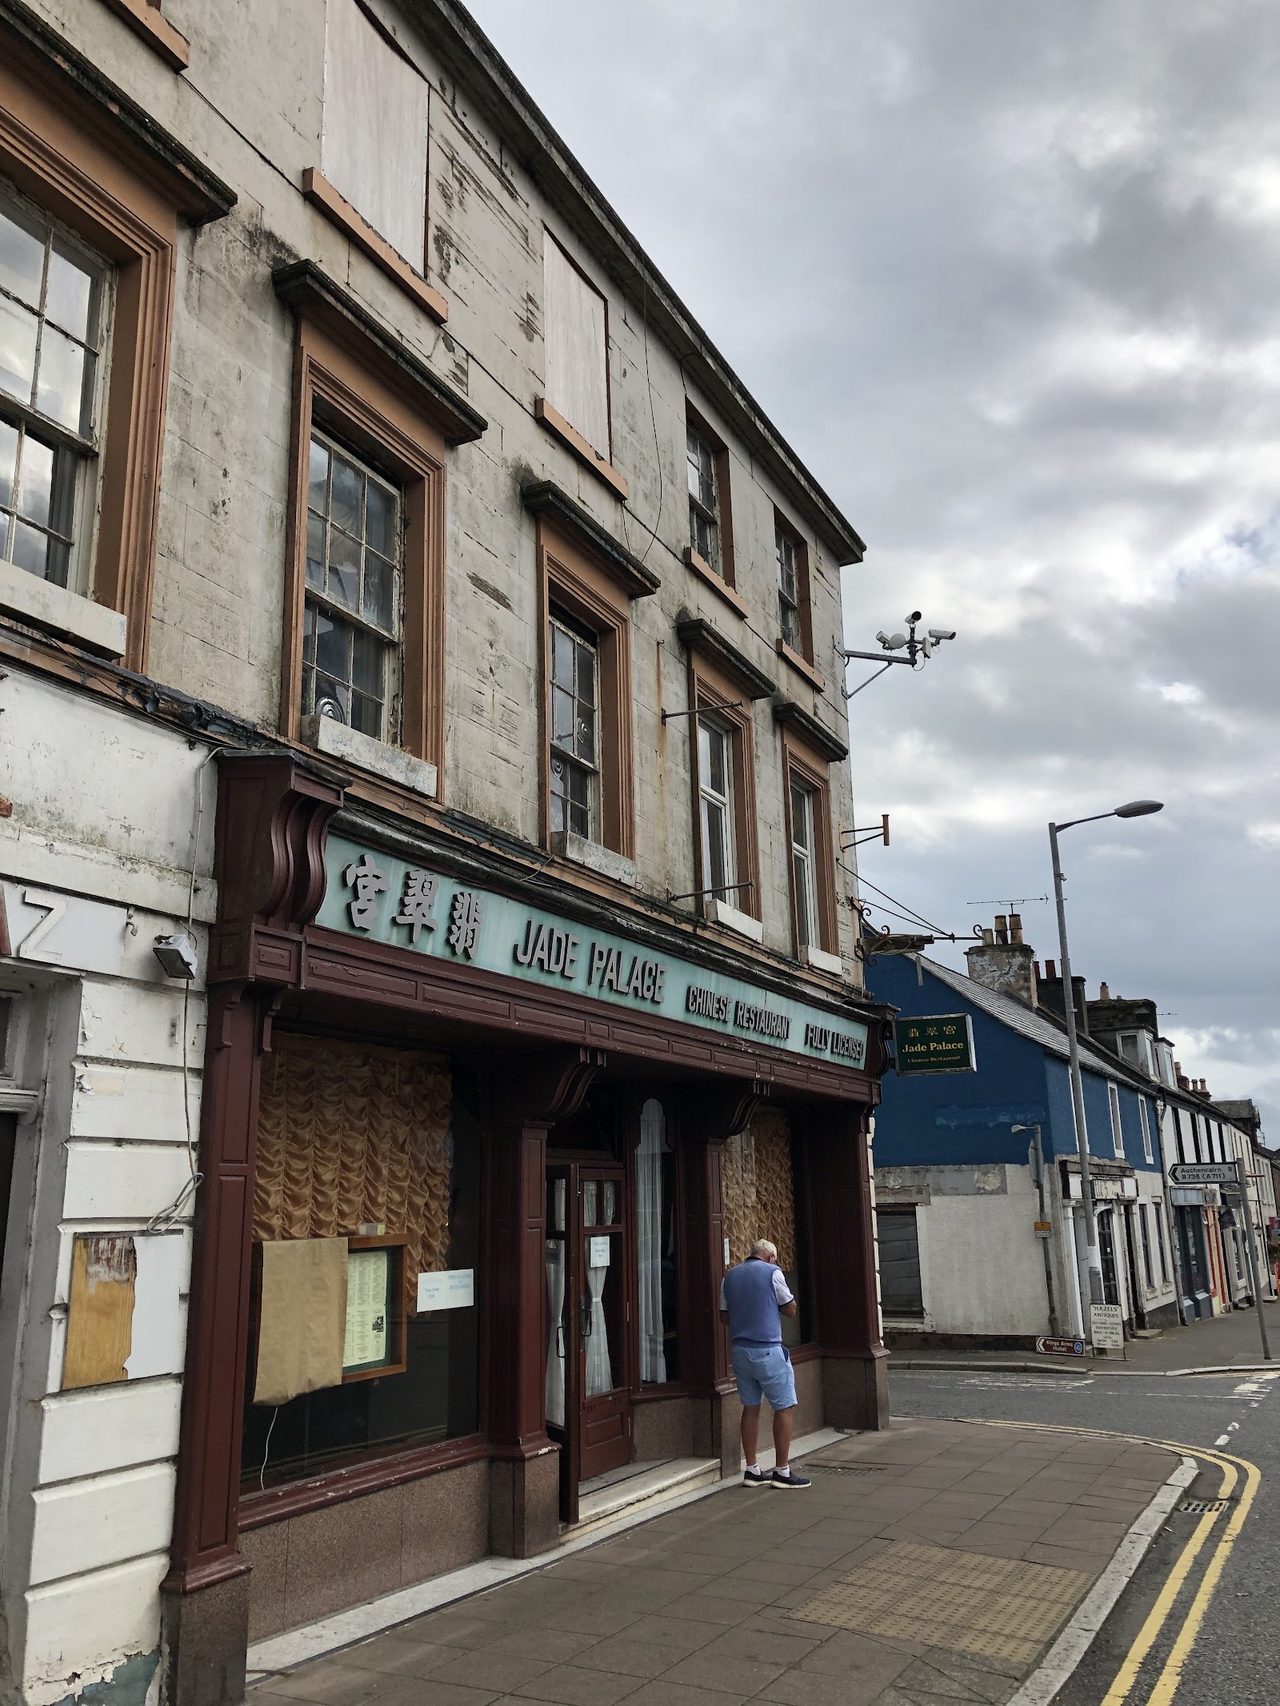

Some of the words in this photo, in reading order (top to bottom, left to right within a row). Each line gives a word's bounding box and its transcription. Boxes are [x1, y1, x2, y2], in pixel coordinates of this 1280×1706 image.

[513, 920, 582, 979] JADE
[588, 943, 667, 1003] PALACE
[734, 1000, 792, 1039] RESTAURANT
[804, 1024, 832, 1051] FULLY
[902, 1044, 927, 1053] Jade
[930, 1042, 964, 1051] Palace
